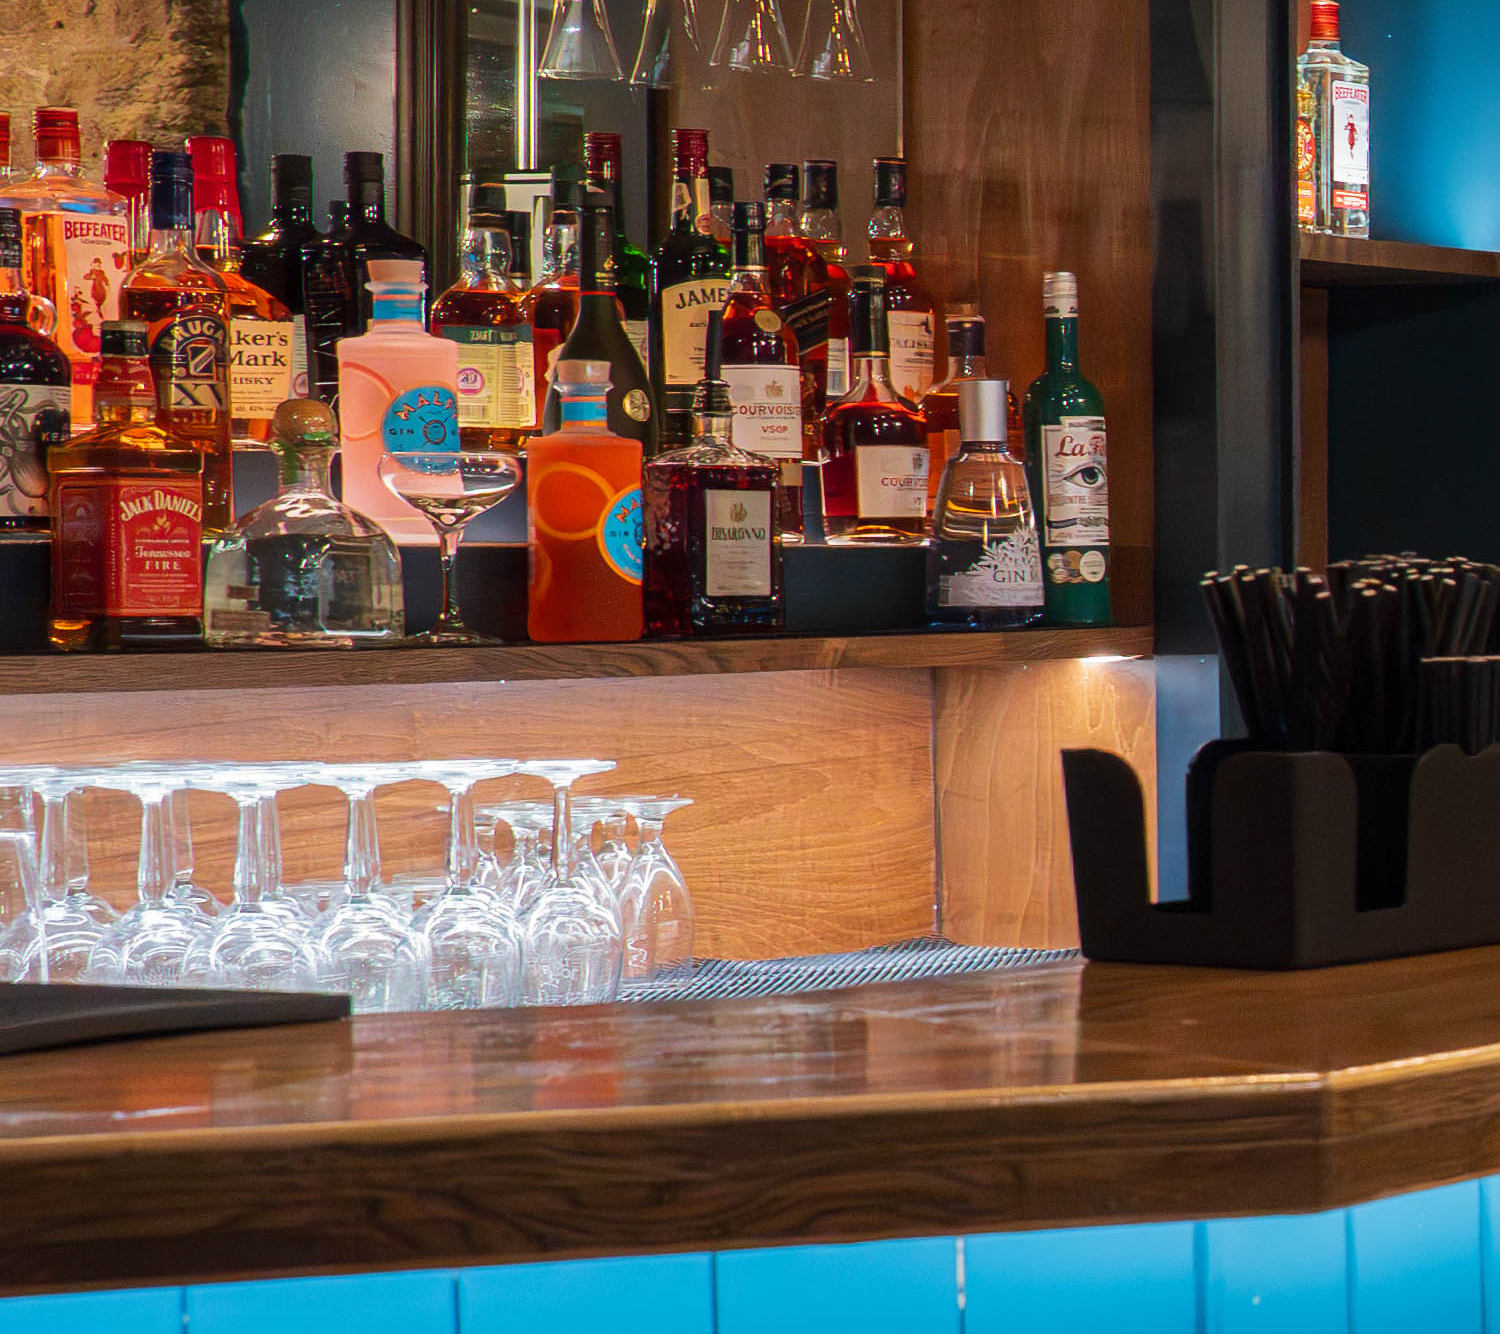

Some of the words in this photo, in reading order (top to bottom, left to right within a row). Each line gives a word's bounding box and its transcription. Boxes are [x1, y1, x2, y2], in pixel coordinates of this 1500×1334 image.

[1335, 86, 1368, 104] BEEFEATER
[64, 219, 126, 242] BEEFEATER
[230, 330, 289, 348] ker's
[389, 427, 414, 436] GIN
[761, 425, 788, 434] VSOP
[1054, 435, 1085, 457] La
[120, 498, 154, 522] JACK
[145, 560, 182, 571] FIRE
[993, 569, 1025, 583] GIN
